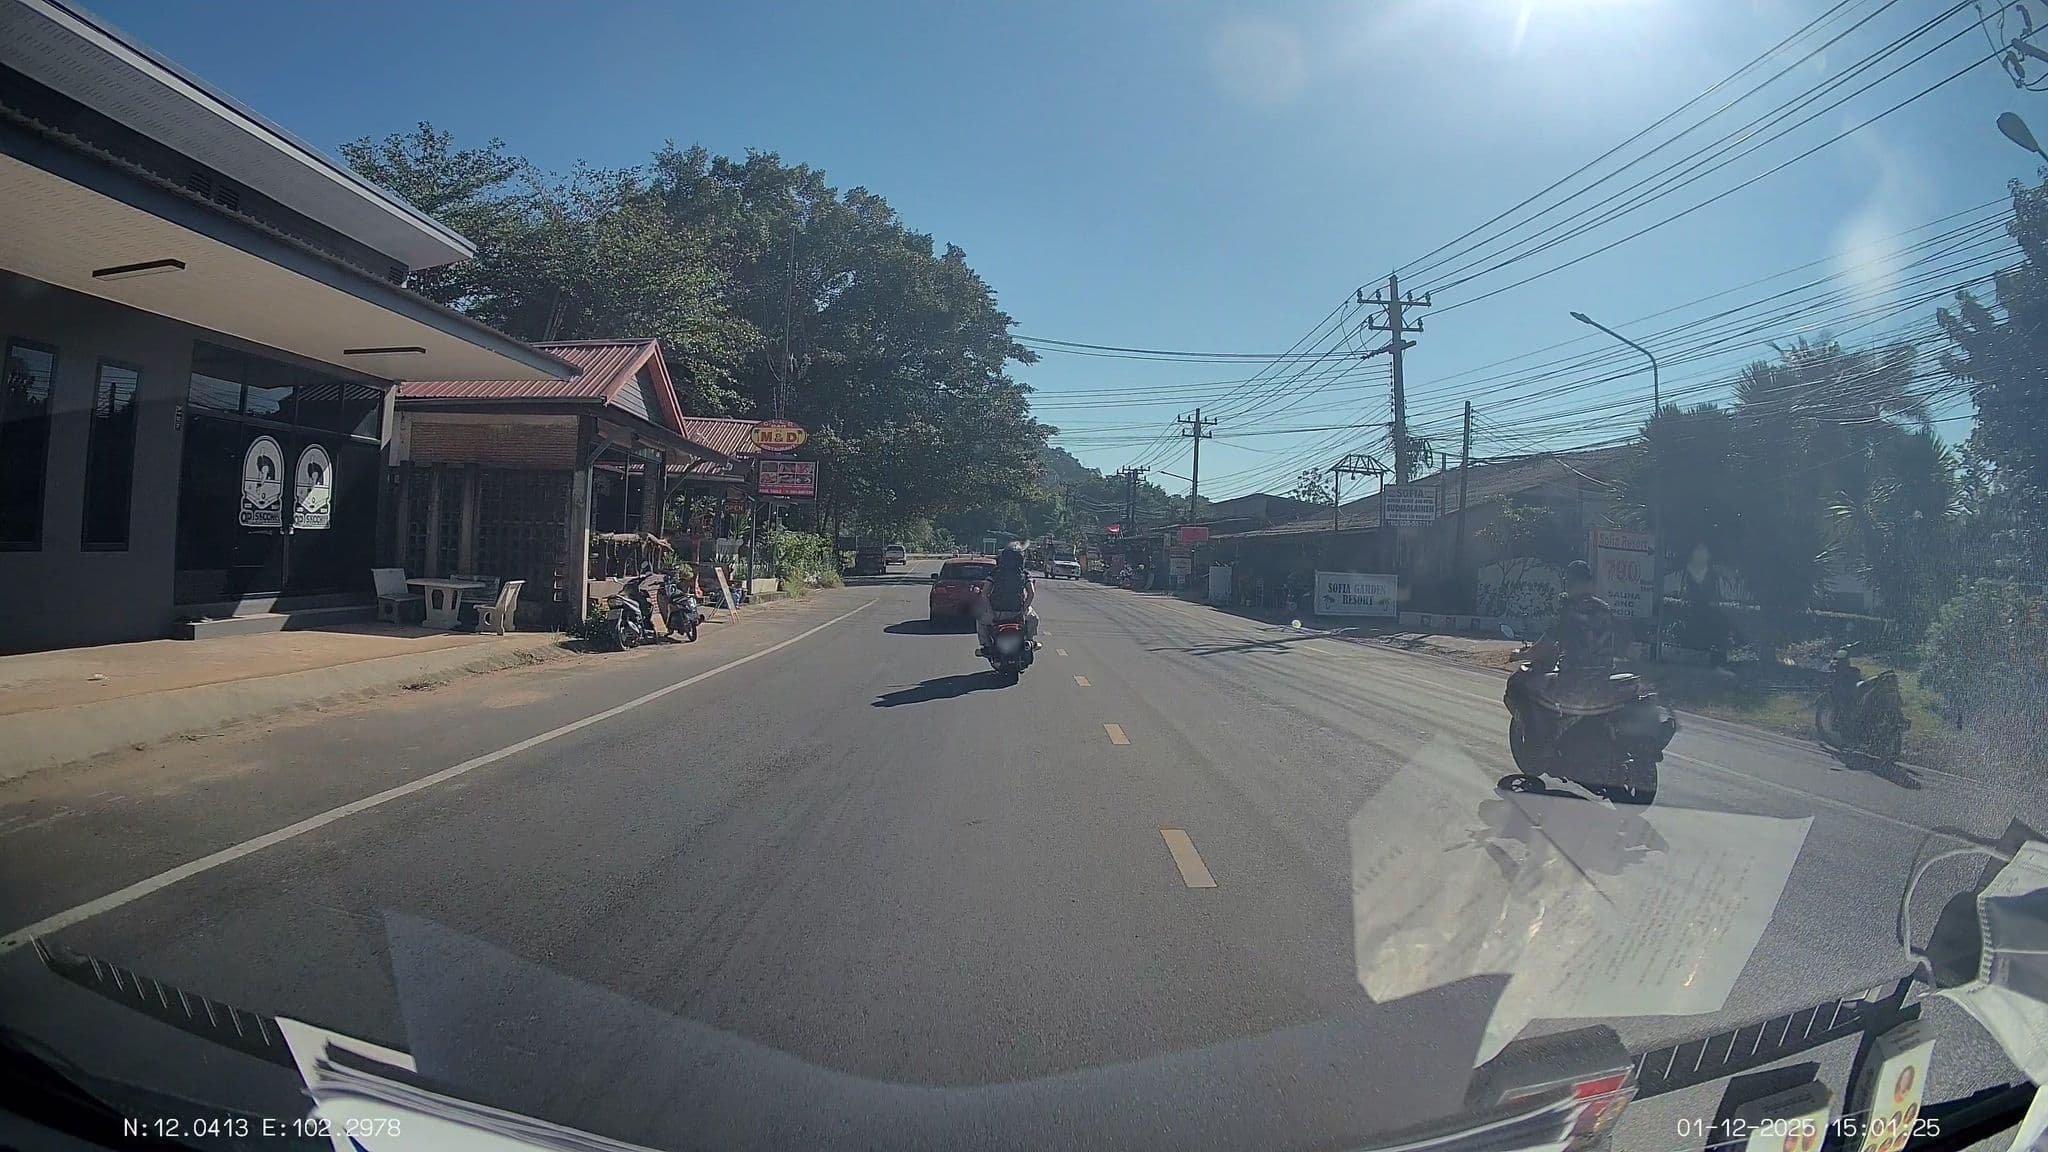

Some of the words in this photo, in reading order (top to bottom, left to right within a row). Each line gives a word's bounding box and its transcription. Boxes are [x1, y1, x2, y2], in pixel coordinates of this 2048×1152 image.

[1327, 582, 1352, 593] SOFIA
[1354, 583, 1387, 595] GARDEN
[1343, 595, 1374, 605] RESORT
